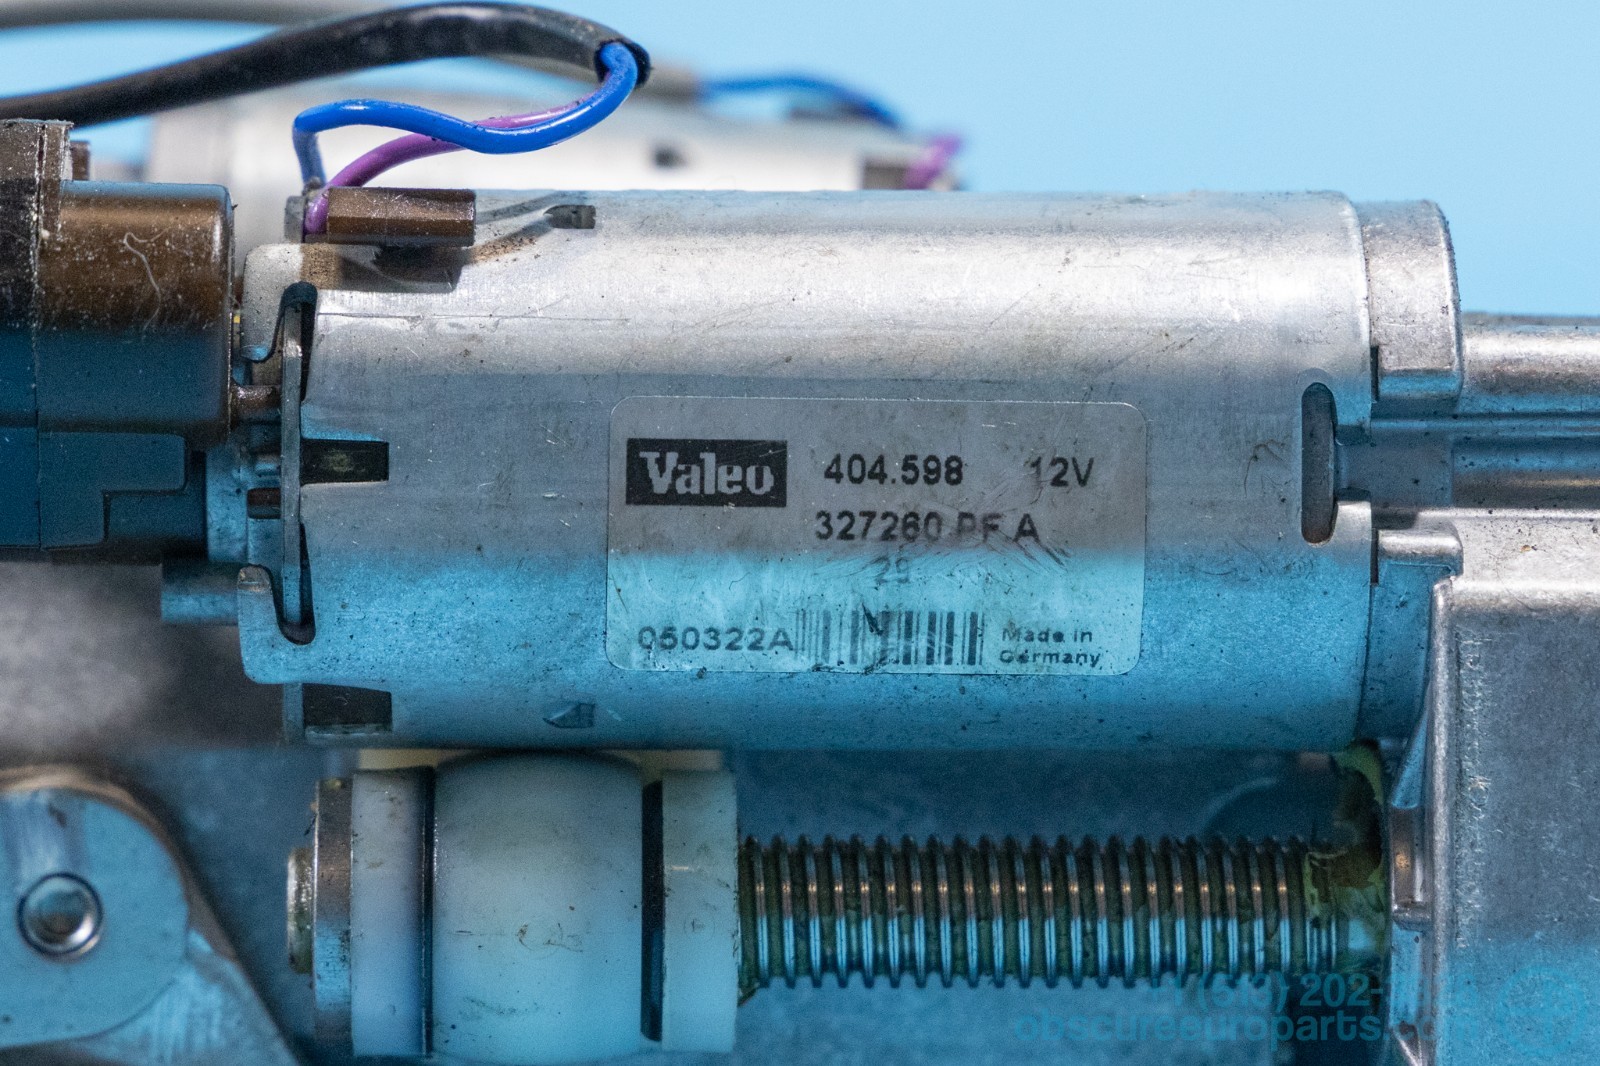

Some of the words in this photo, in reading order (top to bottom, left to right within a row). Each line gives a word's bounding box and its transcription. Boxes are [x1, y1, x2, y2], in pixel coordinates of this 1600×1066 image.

[639, 450, 775, 496] Valeo
[823, 453, 965, 487] 404.598
[1028, 455, 1095, 488] 12V
[815, 510, 944, 543] 327260
[1002, 627, 1065, 643] Made
[1073, 628, 1093, 643] in
[999, 649, 1101, 668] Germany
